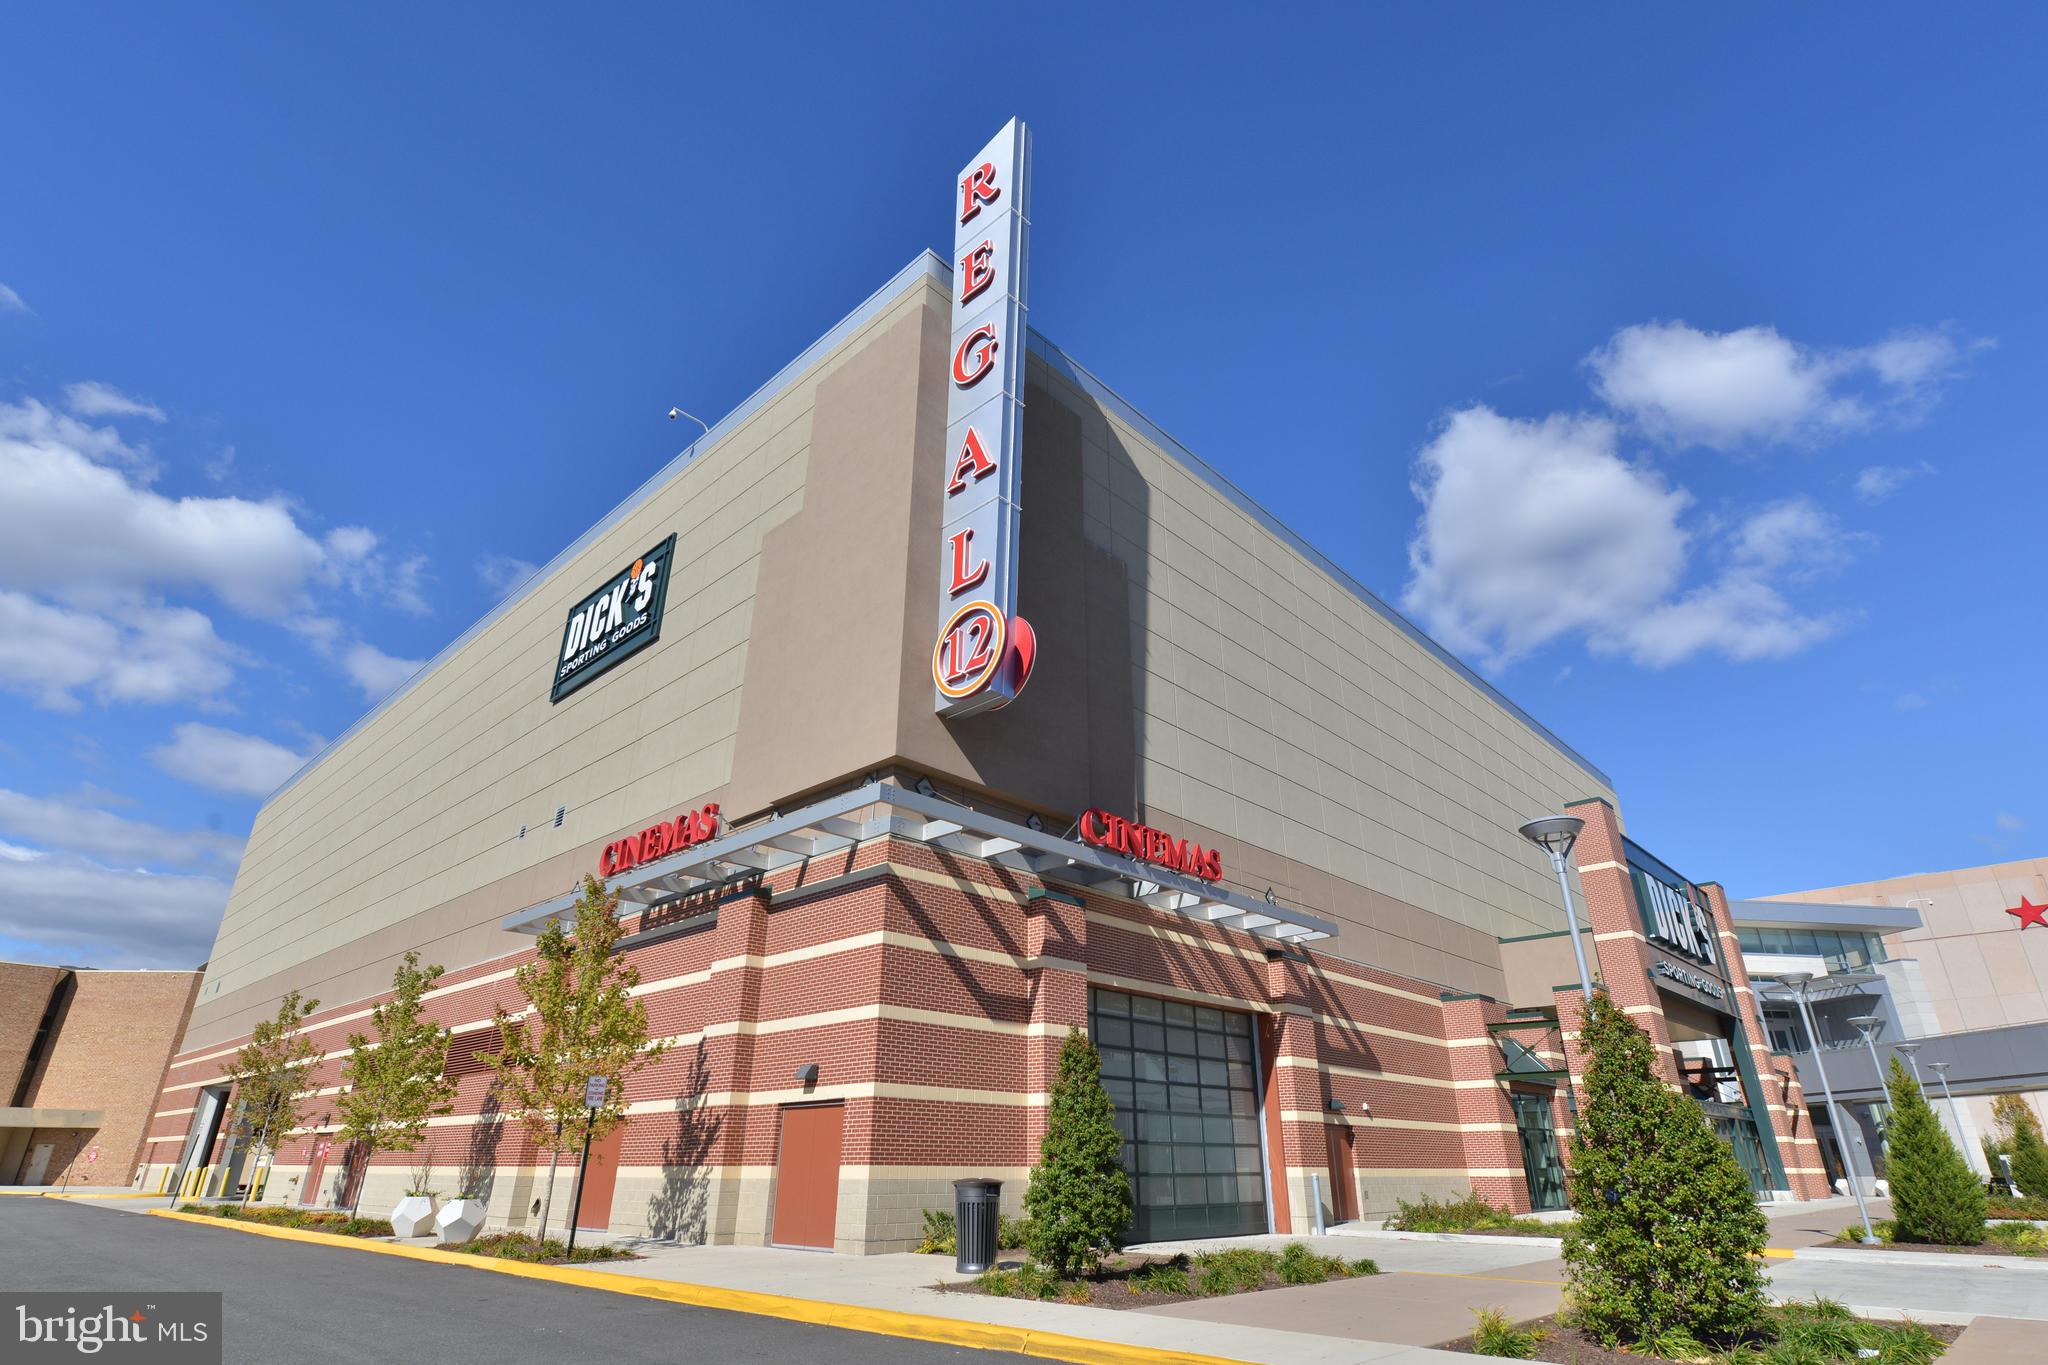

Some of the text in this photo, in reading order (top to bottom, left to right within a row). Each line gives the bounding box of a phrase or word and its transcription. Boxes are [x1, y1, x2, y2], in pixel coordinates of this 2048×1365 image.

[946, 162, 1000, 597] REGAL
[560, 612, 648, 677] SPORTING GOODS
[563, 558, 657, 661] DICK'S
[944, 615, 993, 686] 12
[599, 803, 720, 877] CINEMAS
[1080, 808, 1223, 883] CINEMAS
[1643, 872, 1716, 965] DICK'S
[1662, 960, 1700, 989] SPORTING
